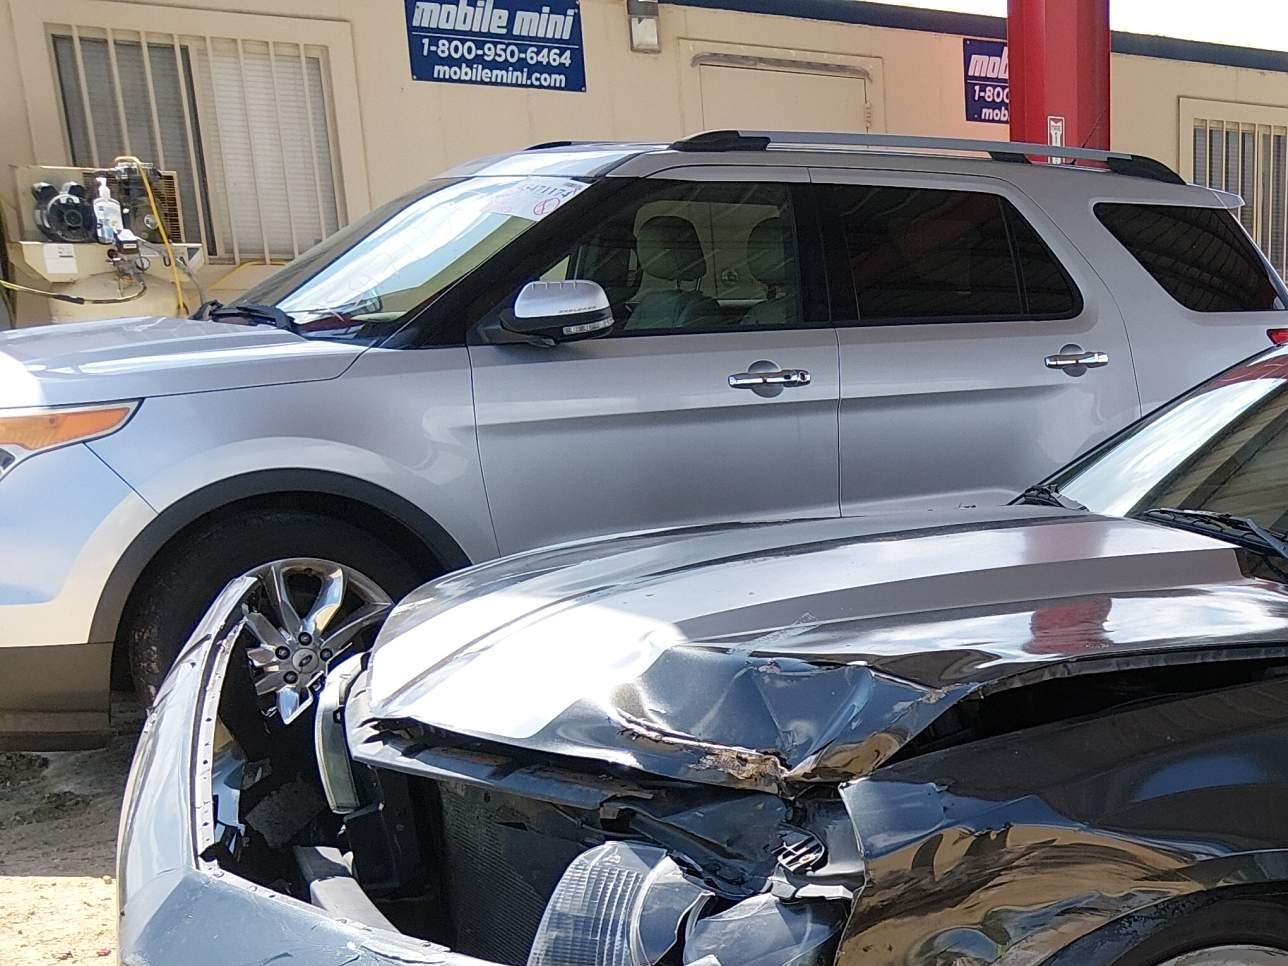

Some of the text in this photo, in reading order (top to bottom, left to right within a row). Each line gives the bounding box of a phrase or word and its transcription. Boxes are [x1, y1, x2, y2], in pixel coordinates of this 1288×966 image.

[412, 0, 575, 40] mobile mini
[421, 38, 572, 67] 1-800-950-6464
[433, 63, 566, 88] mobilemini.com
